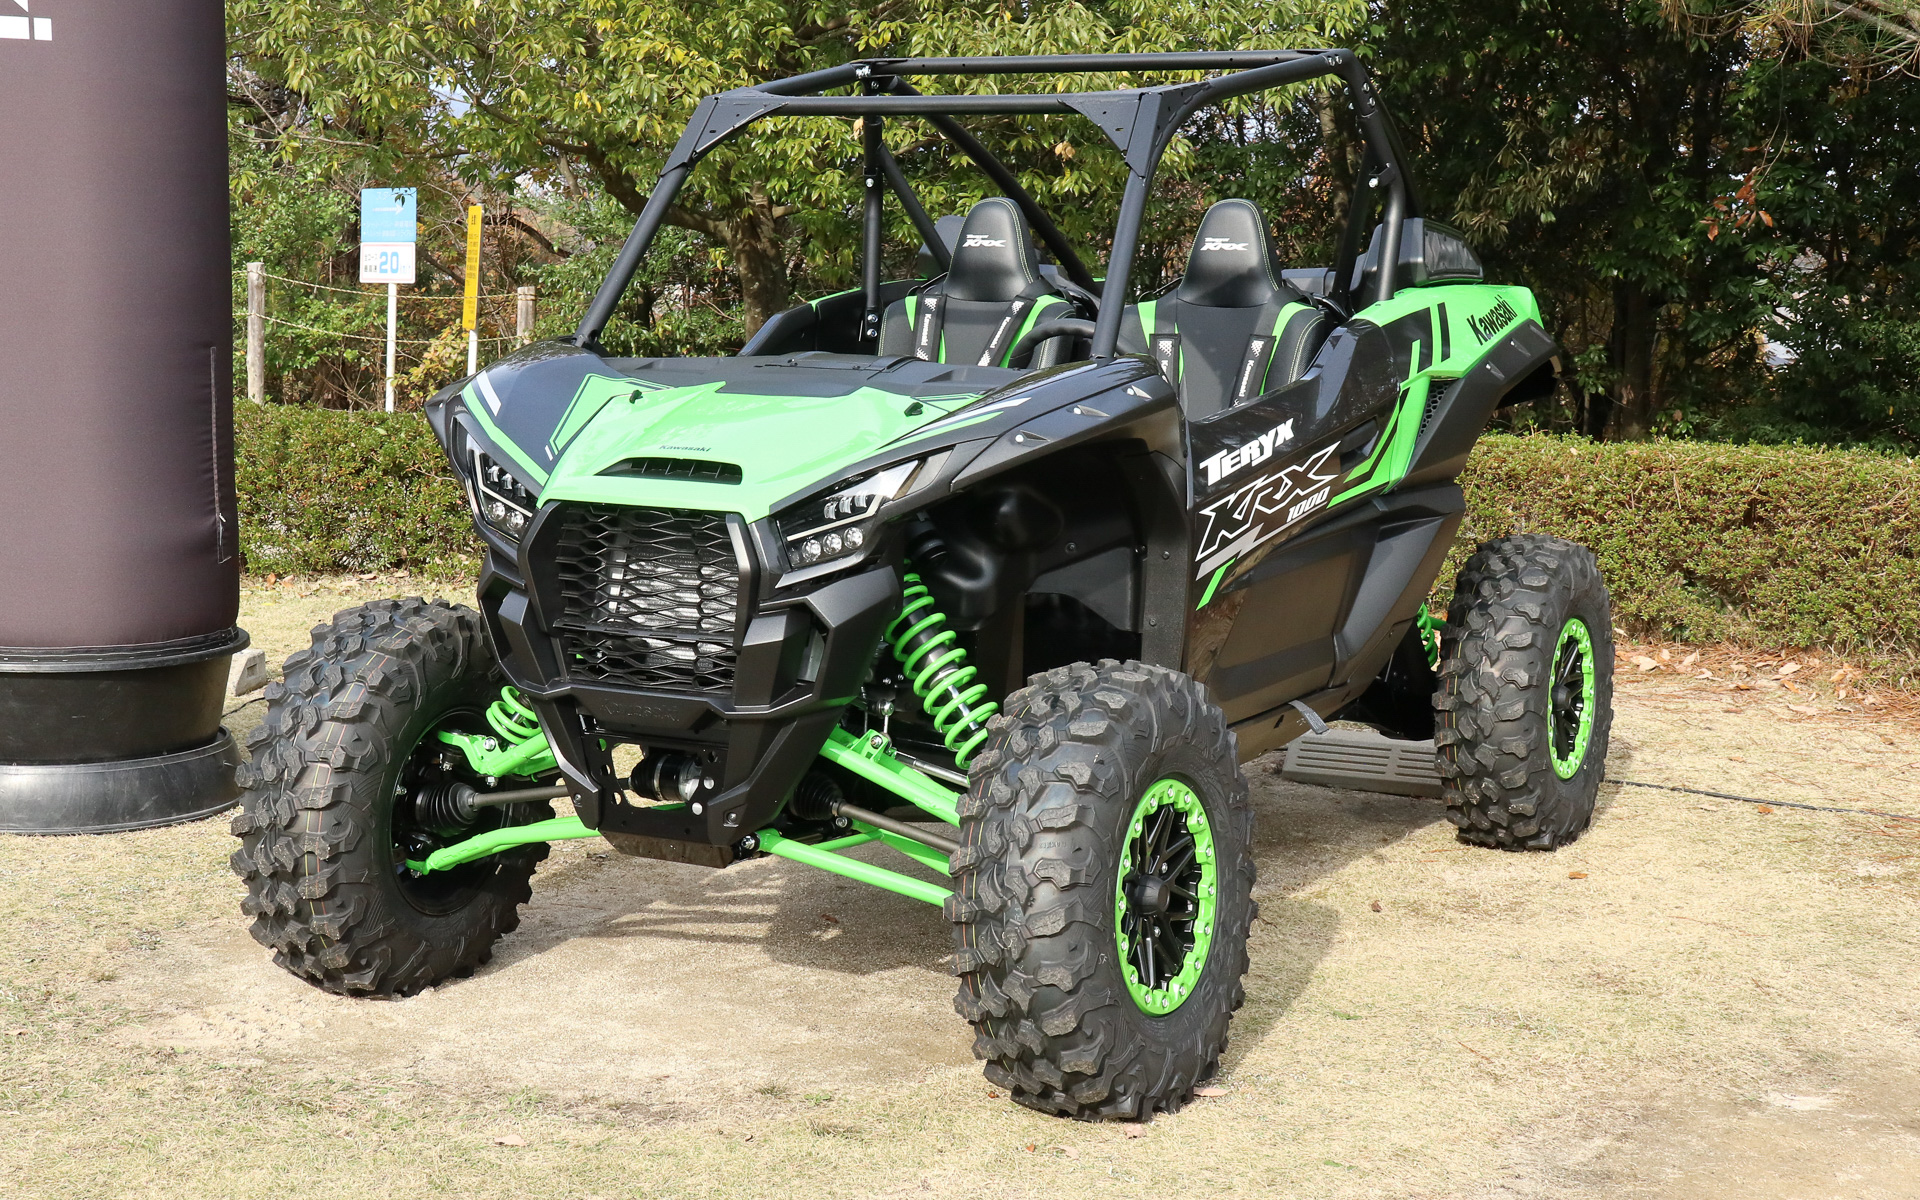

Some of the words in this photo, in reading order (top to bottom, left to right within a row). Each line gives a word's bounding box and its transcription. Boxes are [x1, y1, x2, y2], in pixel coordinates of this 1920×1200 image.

[962, 239, 1007, 248] KRX
[1200, 242, 1249, 251] KRX
[379, 251, 399, 274] 20
[921, 313, 932, 346] Kawasaki
[989, 316, 1011, 349] Kawasaki
[1466, 294, 1518, 346] Kawasaki
[1239, 360, 1255, 397] Kawasaki
[1194, 440, 1342, 562] KRX
[1285, 485, 1331, 523] 1000
